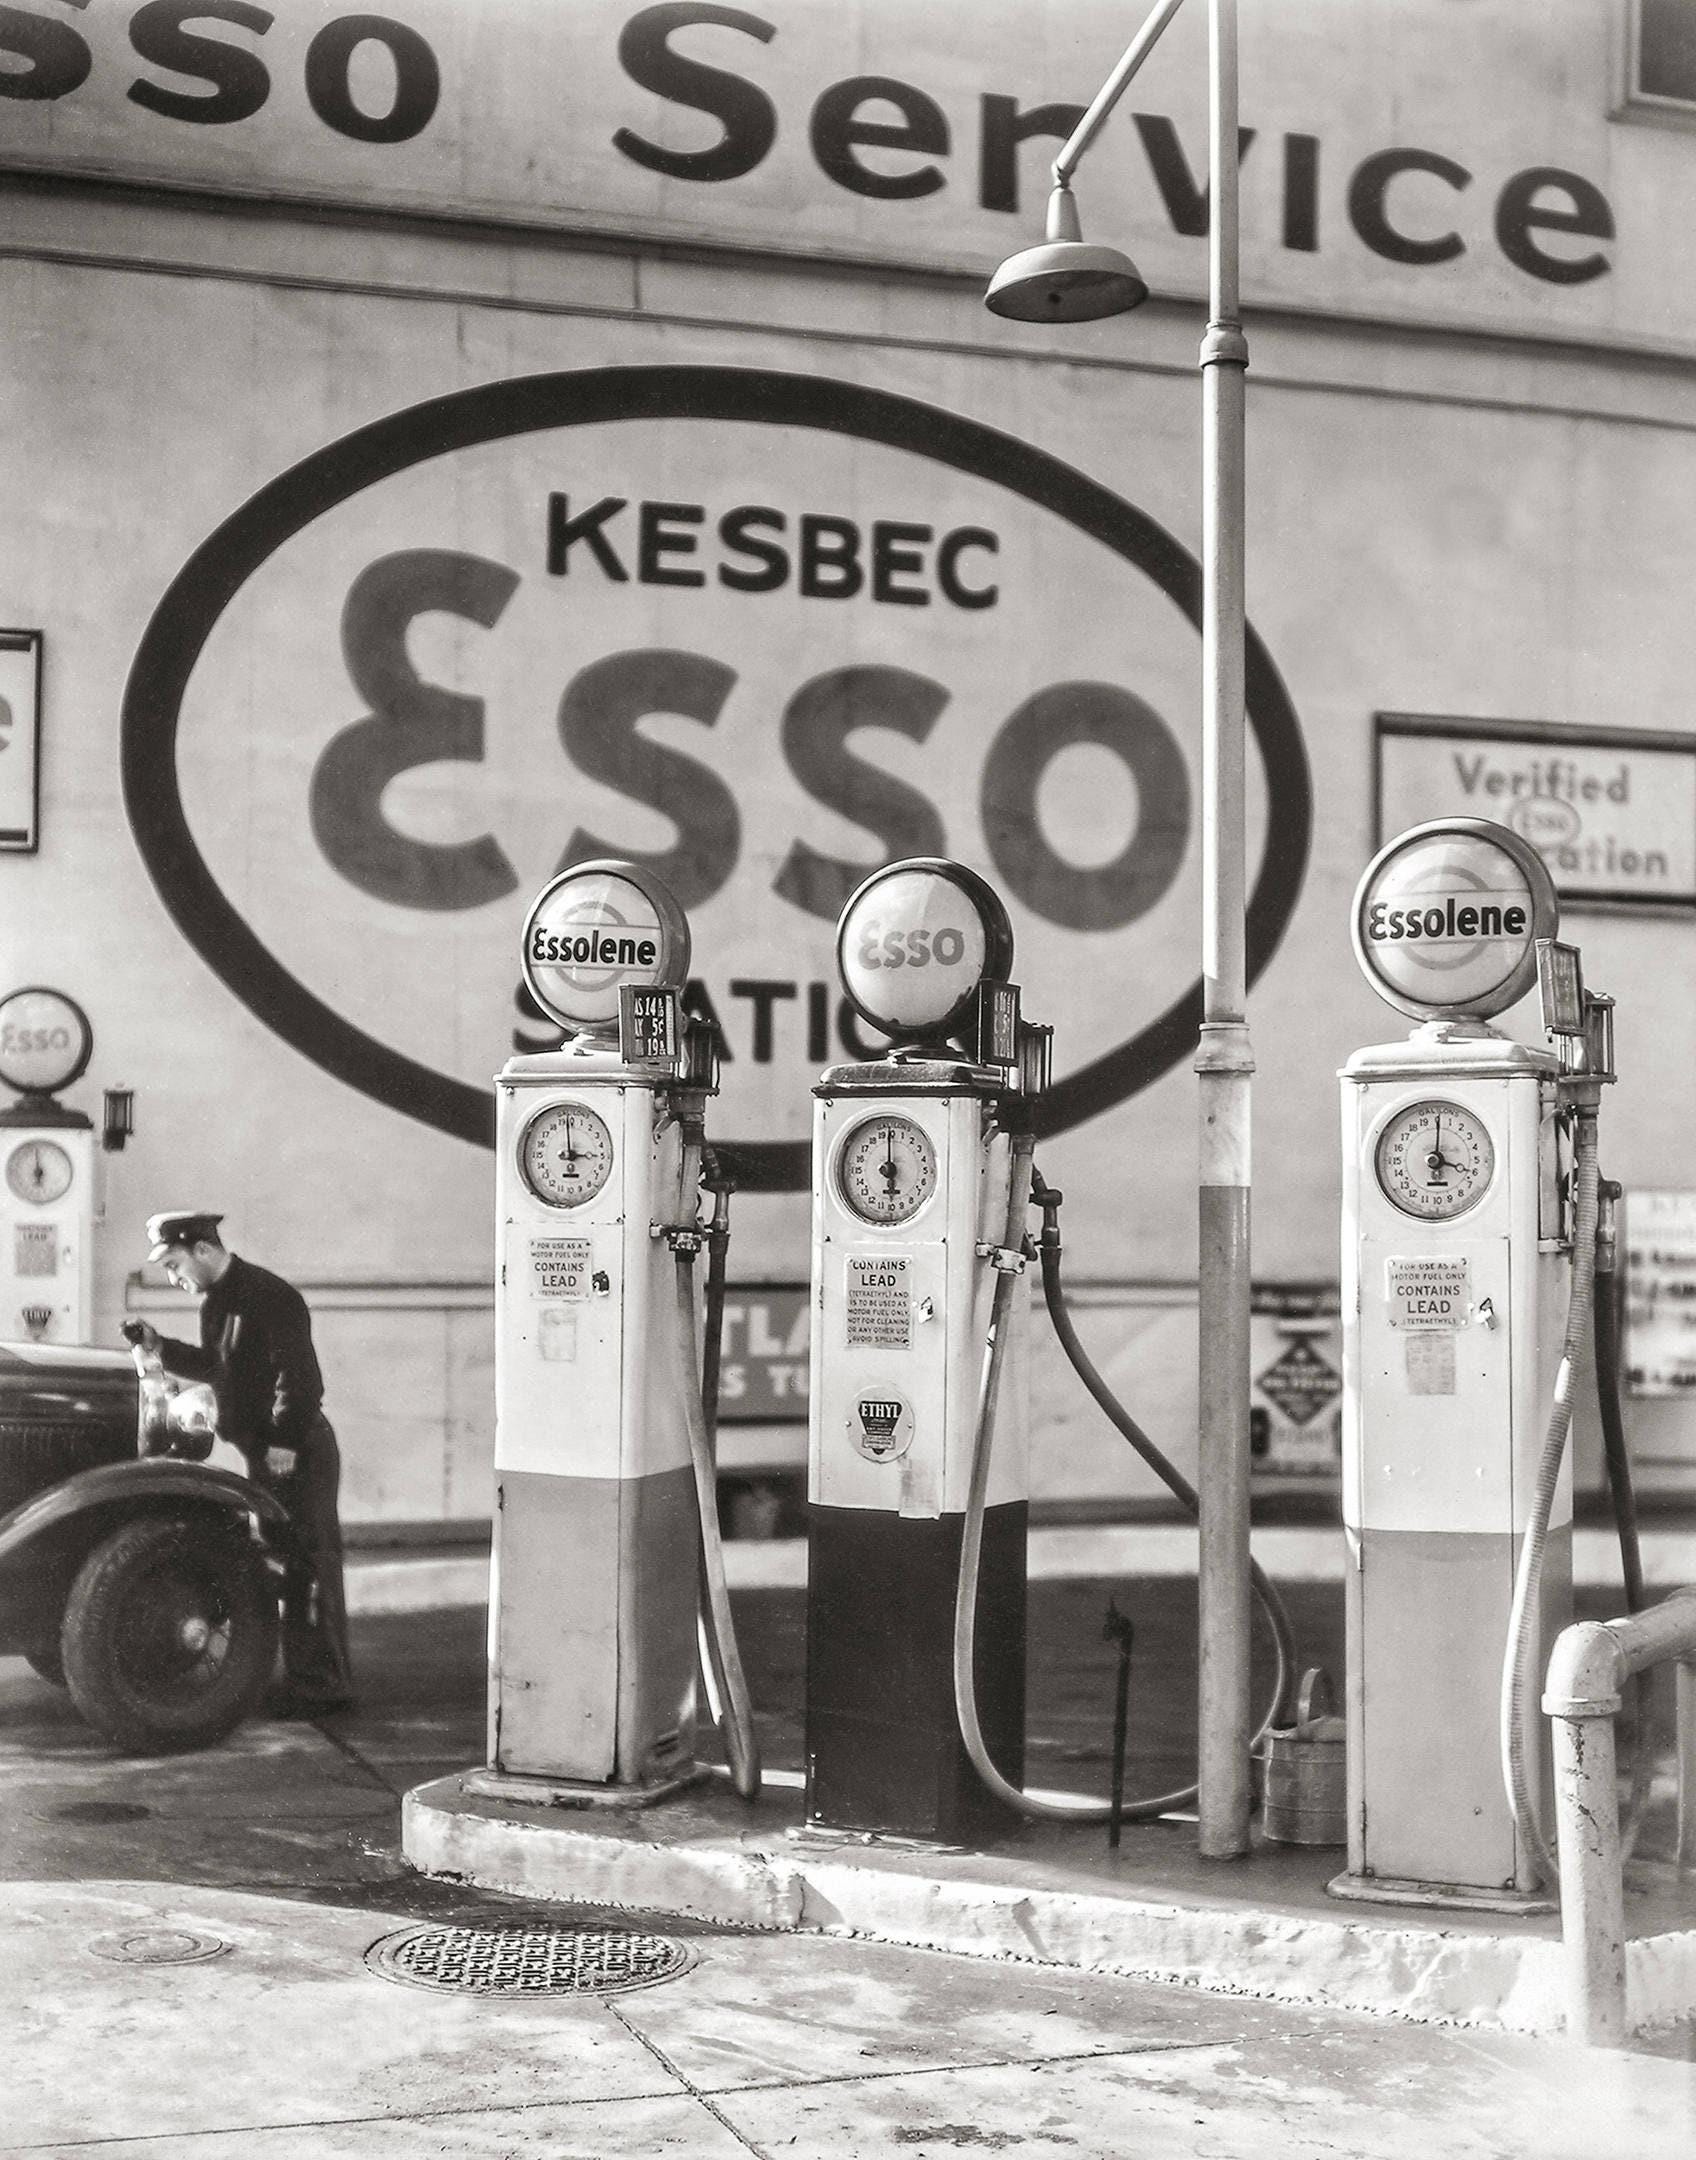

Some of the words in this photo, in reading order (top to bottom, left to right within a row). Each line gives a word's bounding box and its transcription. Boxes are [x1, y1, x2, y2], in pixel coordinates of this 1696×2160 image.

[611, 1, 1618, 286] Service
[547, 491, 1000, 611] KESBEC
[1453, 752, 1631, 804] Verified
[1369, 898, 1527, 941] Essolene
[532, 927, 657, 965] Essolene
[1409, 1124, 1418, 1132] 18
[1459, 1123, 1464, 1131] 2
[1401, 1133, 1409, 1141] 17
[1467, 1132, 1472, 1140] 3
[1394, 1144, 1403, 1152] 16
[1393, 1157, 1401, 1165] 15
[1474, 1156, 1480, 1164] 5
[1472, 1168, 1478, 1176] 6
[1409, 1190, 1418, 1198] 12
[1458, 1189, 1464, 1197] 8
[1433, 1197, 1442, 1205] 10
[534, 1262, 585, 1272] CONTAINS
[853, 1261, 906, 1271] CONTAINS
[861, 1274, 896, 1287] LEAD
[1445, 1272, 1466, 1280] ONLY
[542, 1275, 577, 1287] LEAD
[1397, 1285, 1460, 1296] CONTAINS
[1407, 1300, 1451, 1314] LEAD
[861, 1403, 899, 1418] ETHYL
